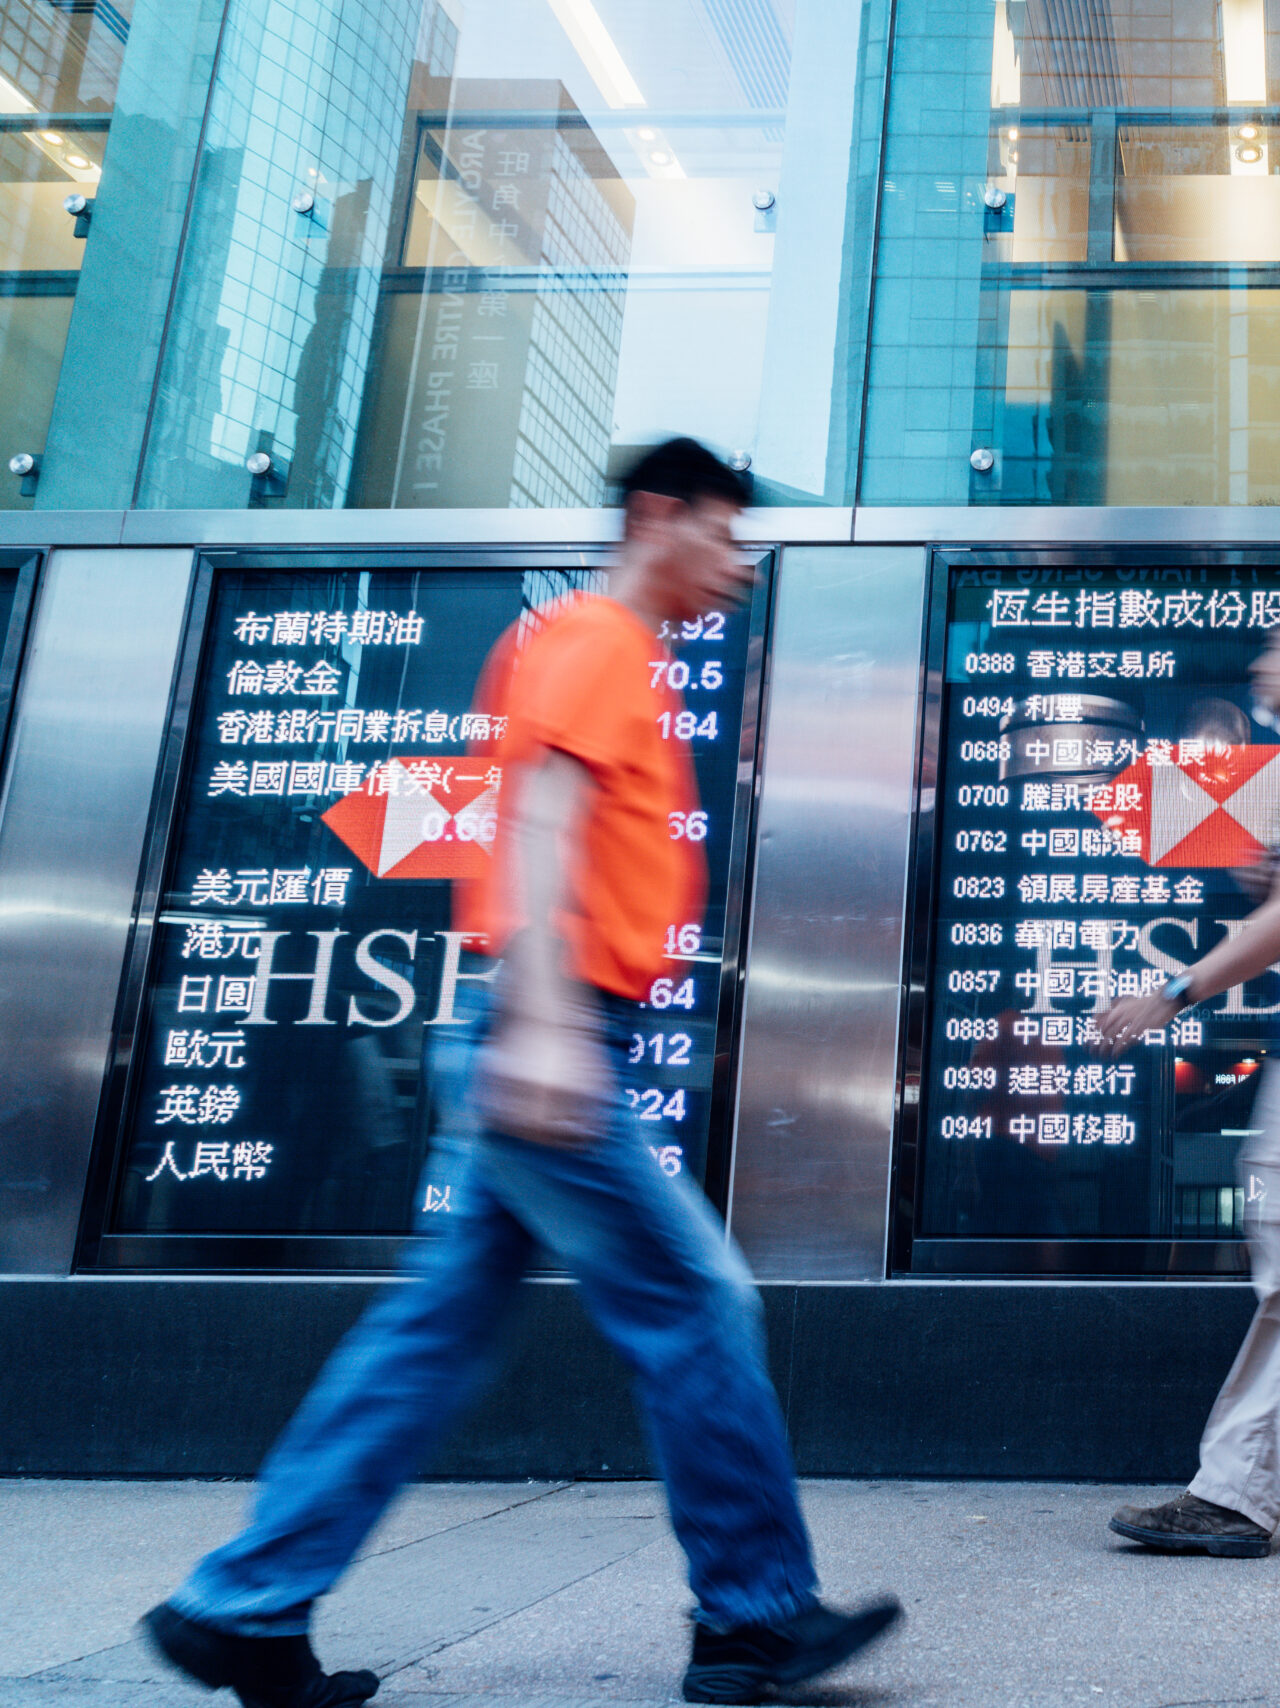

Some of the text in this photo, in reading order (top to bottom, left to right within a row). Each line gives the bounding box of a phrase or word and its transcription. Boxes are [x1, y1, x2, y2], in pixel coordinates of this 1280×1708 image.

[234, 611, 424, 645] 布蘭特期油
[227, 660, 723, 695] 倫敦金 70.5
[965, 652, 1015, 674] 0388
[1027, 651, 1175, 678] 香港交易所
[963, 697, 1015, 717] 0494
[1025, 694, 1083, 721] 利豐
[656, 711, 718, 740] 184
[961, 741, 1012, 761] 0688
[1025, 739, 1206, 766] 中國海外發展
[958, 785, 1009, 806] 0700
[1020, 783, 1143, 811] 騰訊控股
[956, 829, 1142, 856] 0762 中國聯通
[190, 868, 352, 905] 美元匯價
[954, 875, 1204, 903] 0823 領展房產基金
[182, 921, 262, 959] 港元
[951, 919, 1139, 950] 0836 華潤電力
[177, 974, 256, 1012] 日圓
[948, 970, 1001, 992] 0857
[946, 1018, 999, 1040] 0883
[1013, 1016, 1202, 1045] 中國海石油
[164, 1030, 246, 1067] 歐元
[944, 1067, 997, 1089] 0939
[1008, 1065, 1135, 1095] 建設銀行
[155, 1085, 240, 1124] 英鎊
[941, 1116, 993, 1139] 0941
[1009, 1114, 1135, 1144] 中國移動
[146, 1141, 274, 1181] 人民幣
[422, 1184, 451, 1212] 以
